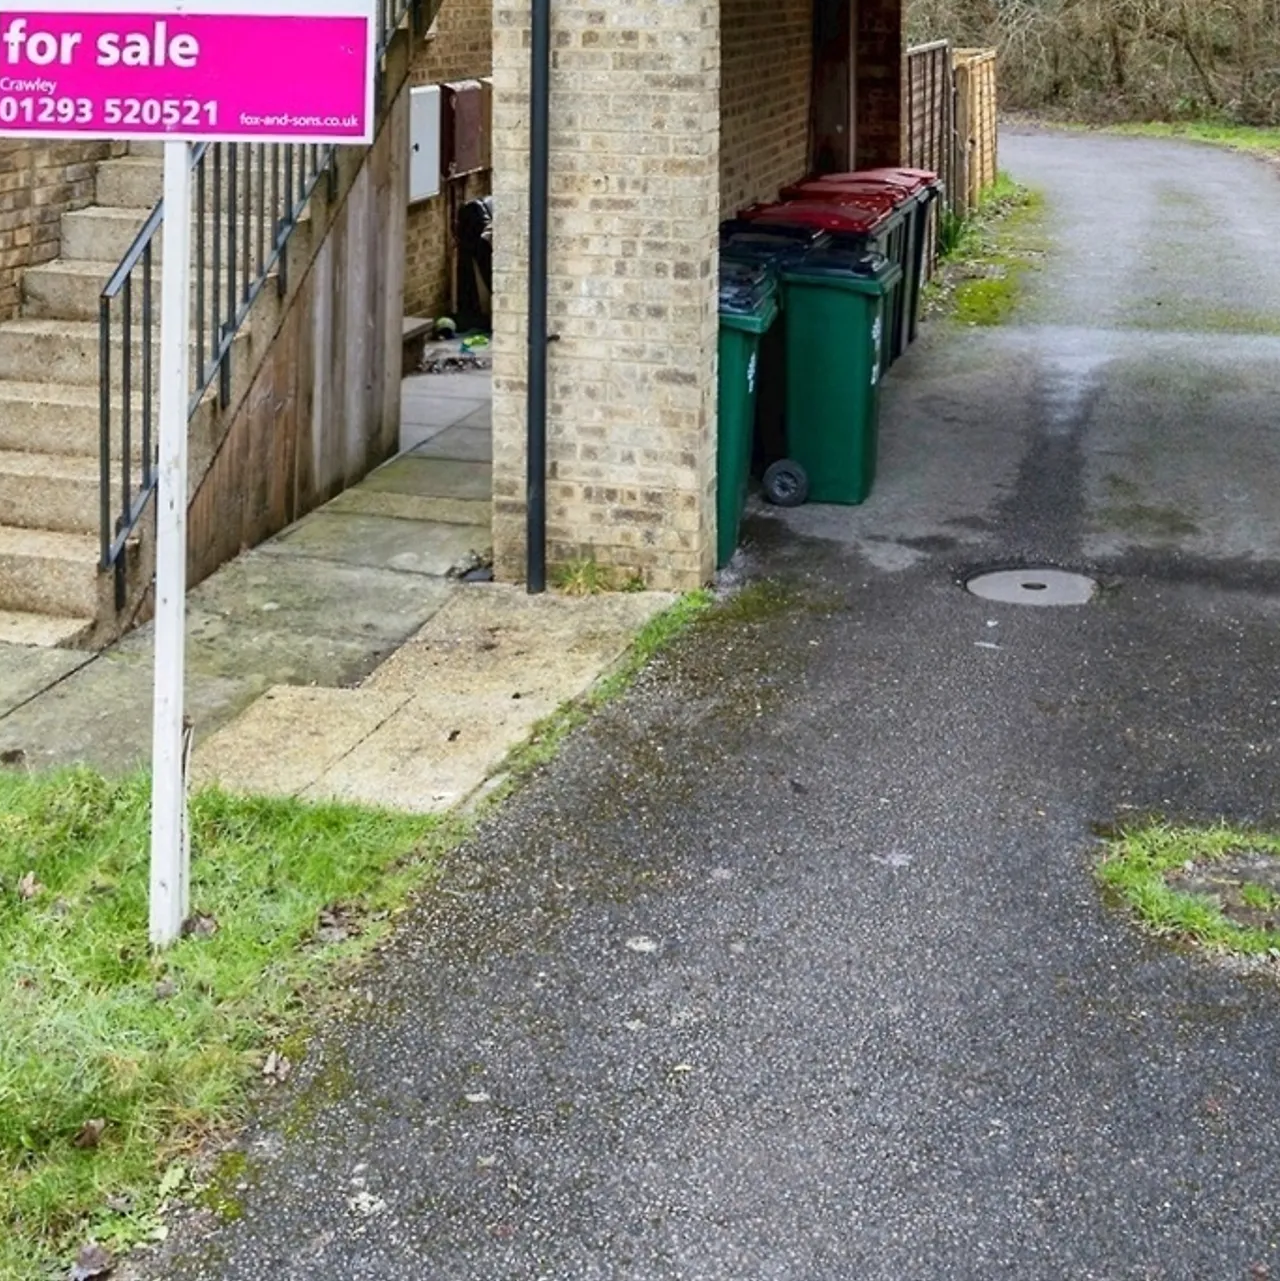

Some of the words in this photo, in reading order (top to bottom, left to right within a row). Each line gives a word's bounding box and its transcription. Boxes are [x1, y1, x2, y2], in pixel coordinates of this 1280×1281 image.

[2, 19, 81, 66] for
[95, 21, 200, 67] sale
[0, 77, 57, 95] Crawley
[104, 98, 219, 126] 520521
[239, 112, 359, 129] fox-and-sons.co.uk
